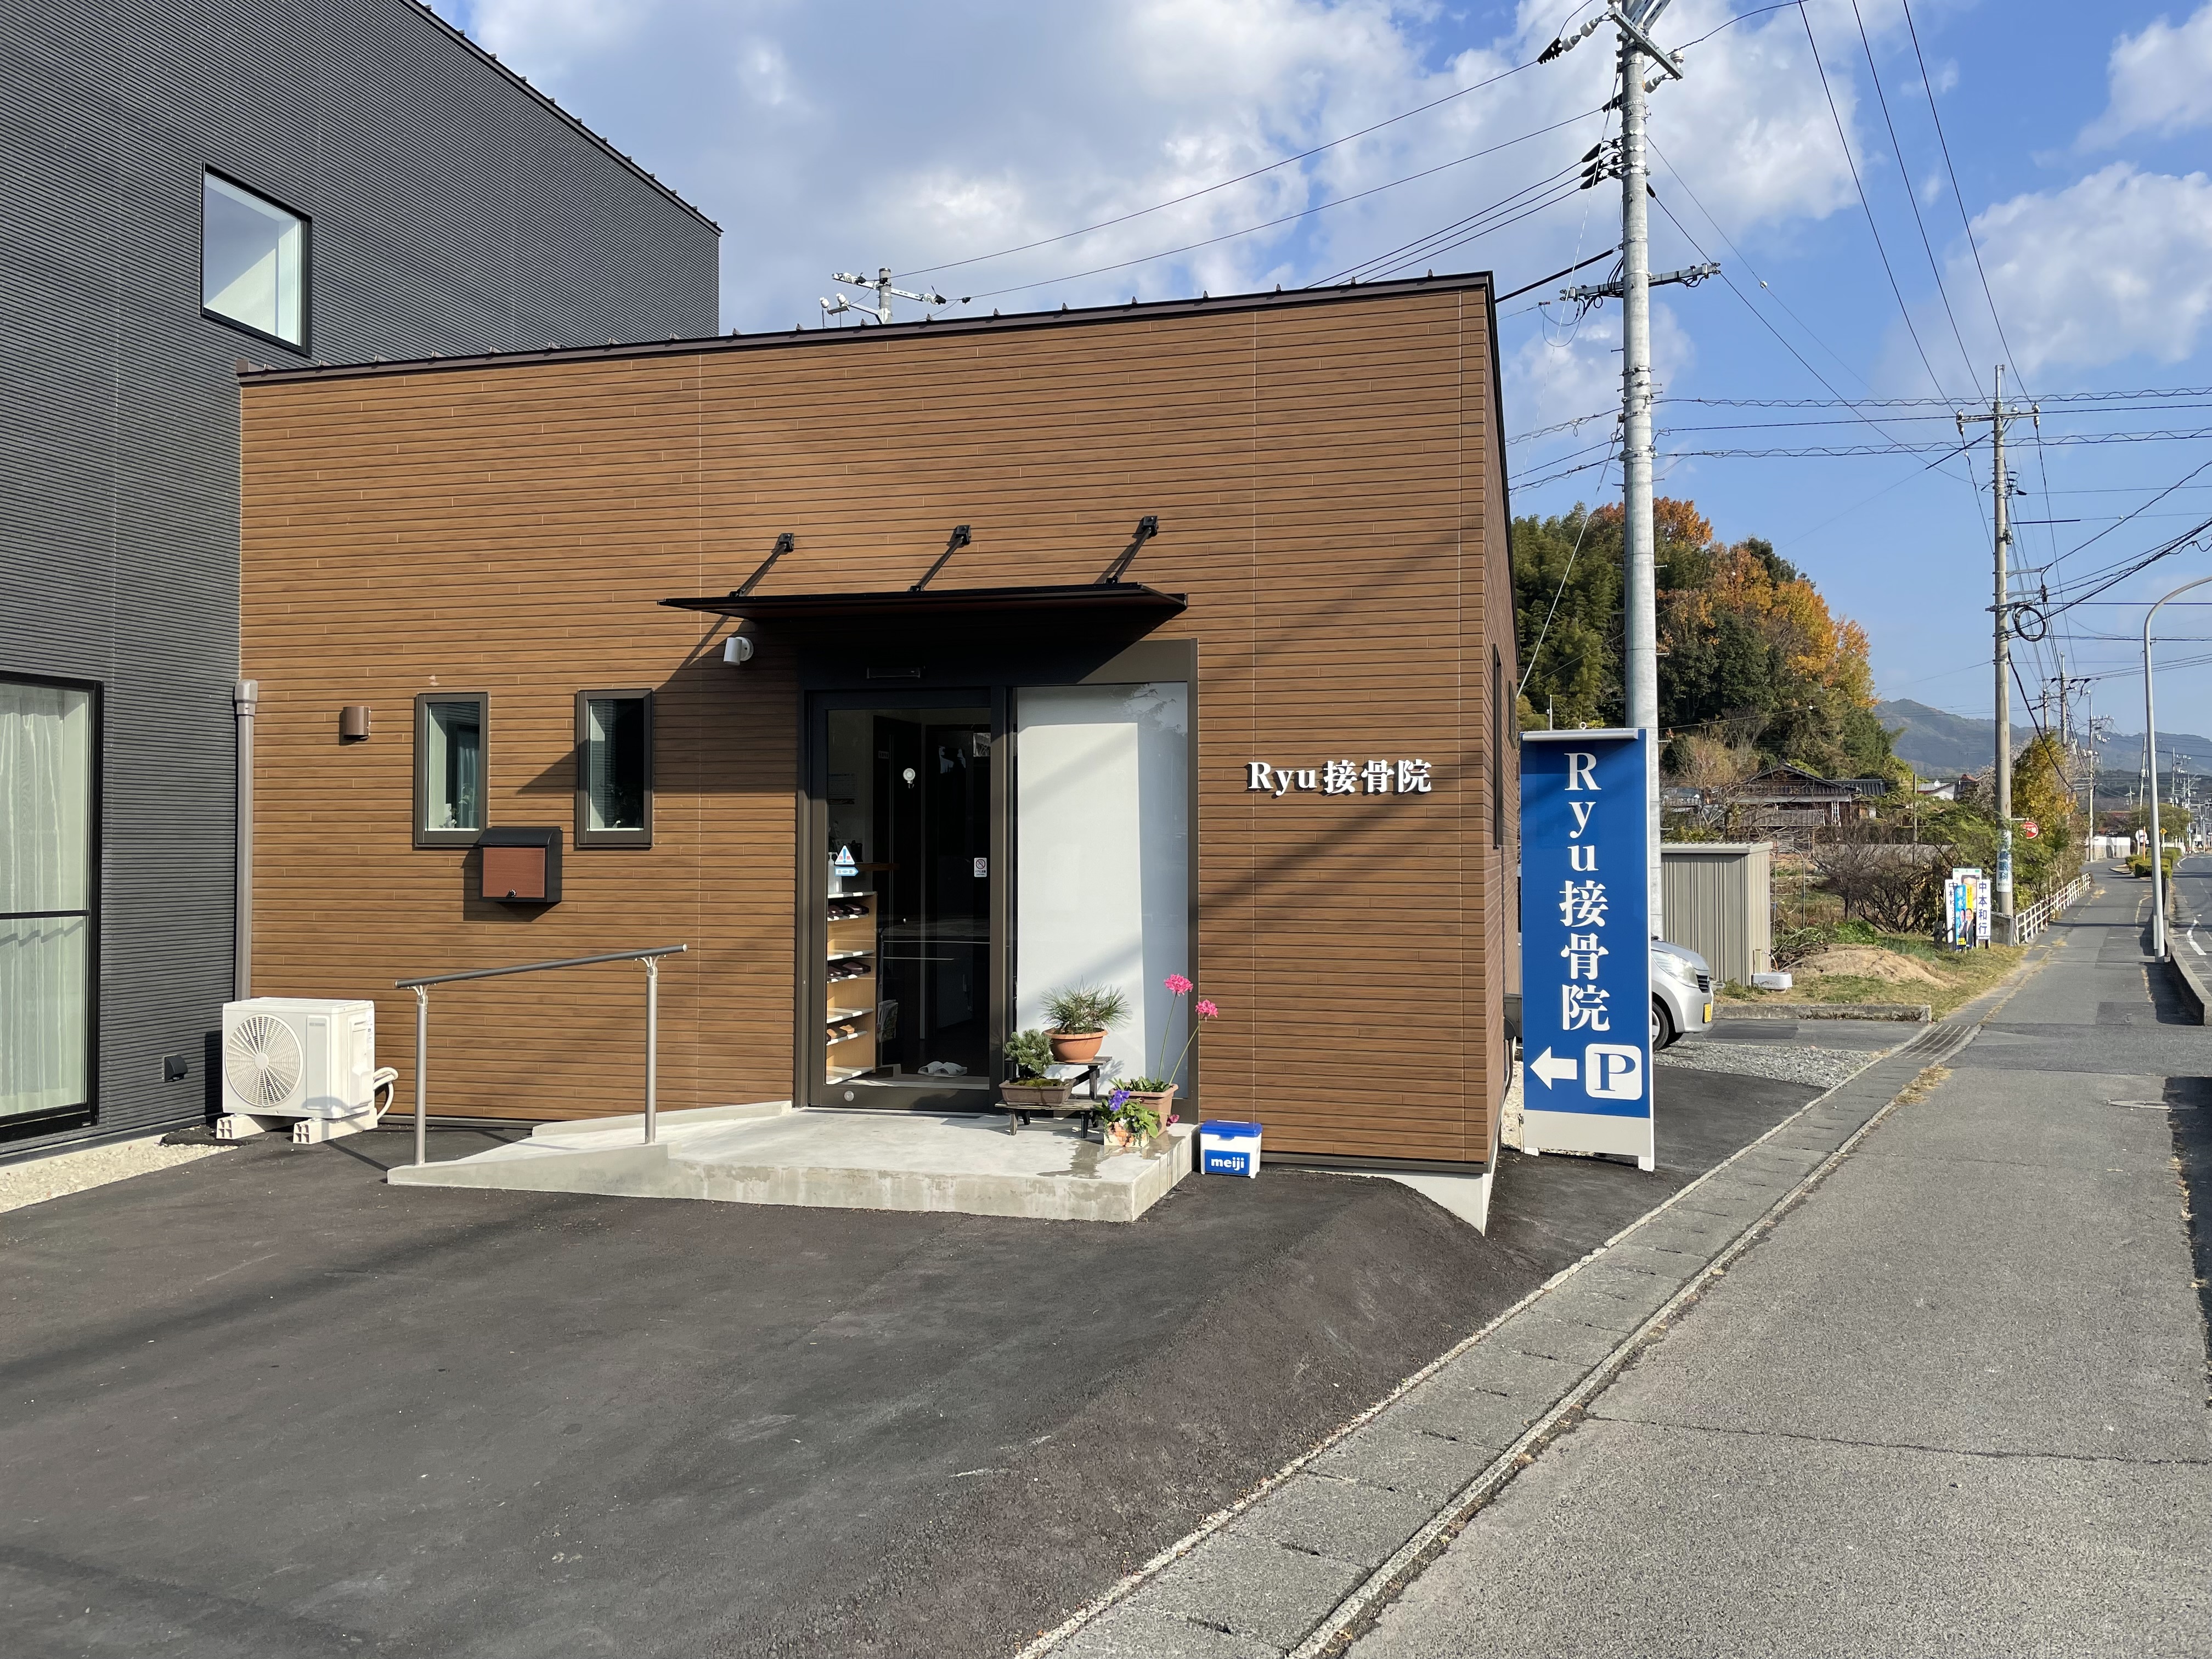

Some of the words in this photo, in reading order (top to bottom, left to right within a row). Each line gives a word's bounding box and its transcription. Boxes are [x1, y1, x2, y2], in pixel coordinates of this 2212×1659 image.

[1248, 759, 1432, 796] Ryu接骨院
[1559, 752, 1611, 1031] Ryu接骨院
[1978, 881, 1988, 934] 中本和行
[1594, 1052, 1636, 1091] P
[1211, 1156, 1245, 1171] meiji
